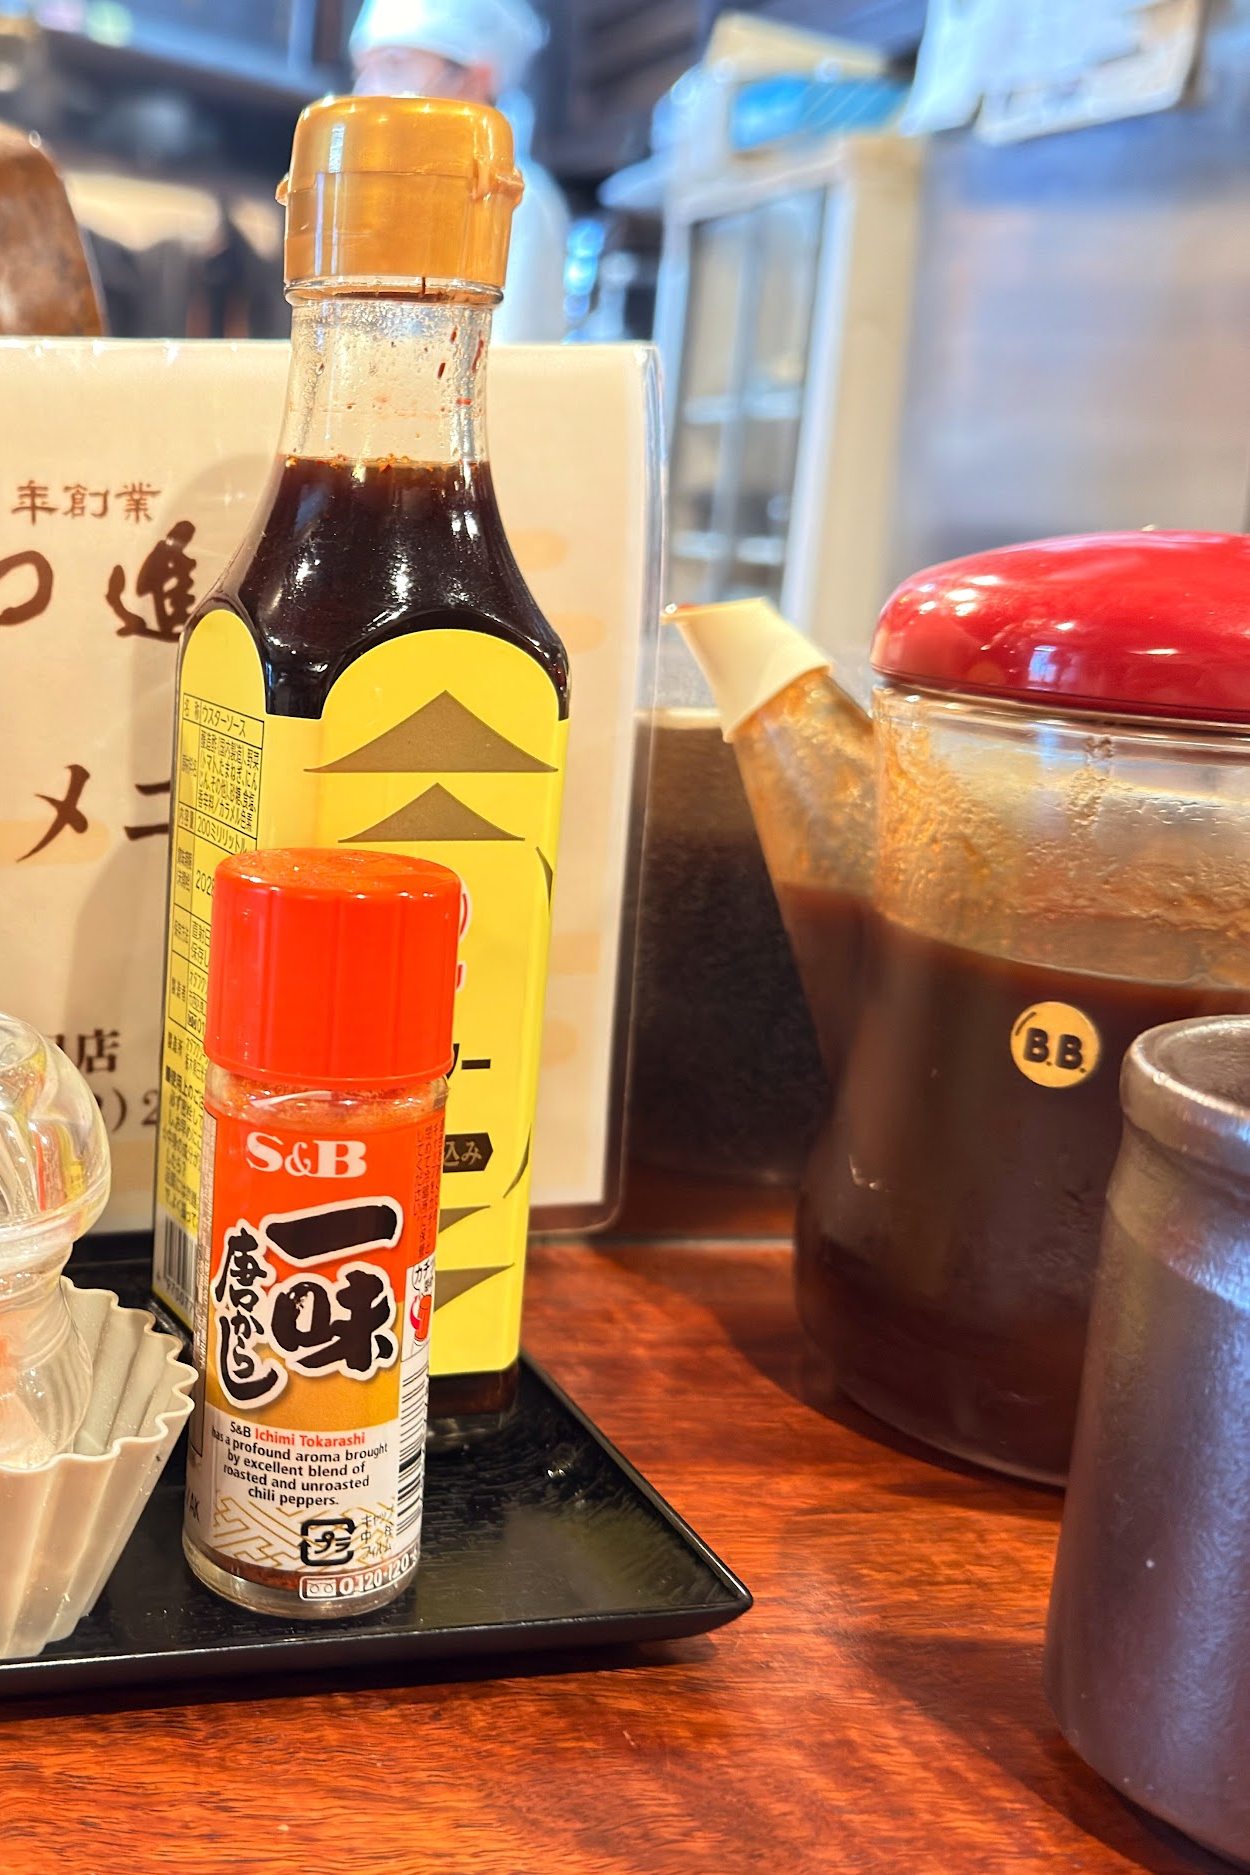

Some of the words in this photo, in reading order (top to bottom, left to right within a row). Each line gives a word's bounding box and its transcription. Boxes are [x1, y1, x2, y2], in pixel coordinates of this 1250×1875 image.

[202, 706, 246, 738] ウスターソース
[45, 1028, 120, 1073] 店
[247, 1132, 367, 1178] S&B
[265, 1204, 399, 1373] 一味
[211, 1427, 224, 1442] has
[225, 1437, 231, 1445] a
[233, 1440, 291, 1460] profound
[295, 1451, 340, 1463] aroma
[345, 1443, 388, 1461] brought
[230, 1421, 251, 1438] S&B
[254, 1428, 295, 1446] Ichimi
[299, 1432, 366, 1448] Tokarashi
[223, 1463, 267, 1486] roasted
[271, 1476, 297, 1491] and
[301, 1475, 370, 1492] unroasted
[227, 1450, 240, 1466] by
[243, 1456, 303, 1477] excellent
[308, 1462, 348, 1477] blend
[352, 1462, 366, 1474] of
[248, 1487, 275, 1502] chili
[279, 1494, 339, 1509] peppers.
[314, 1530, 352, 1555] プラ
